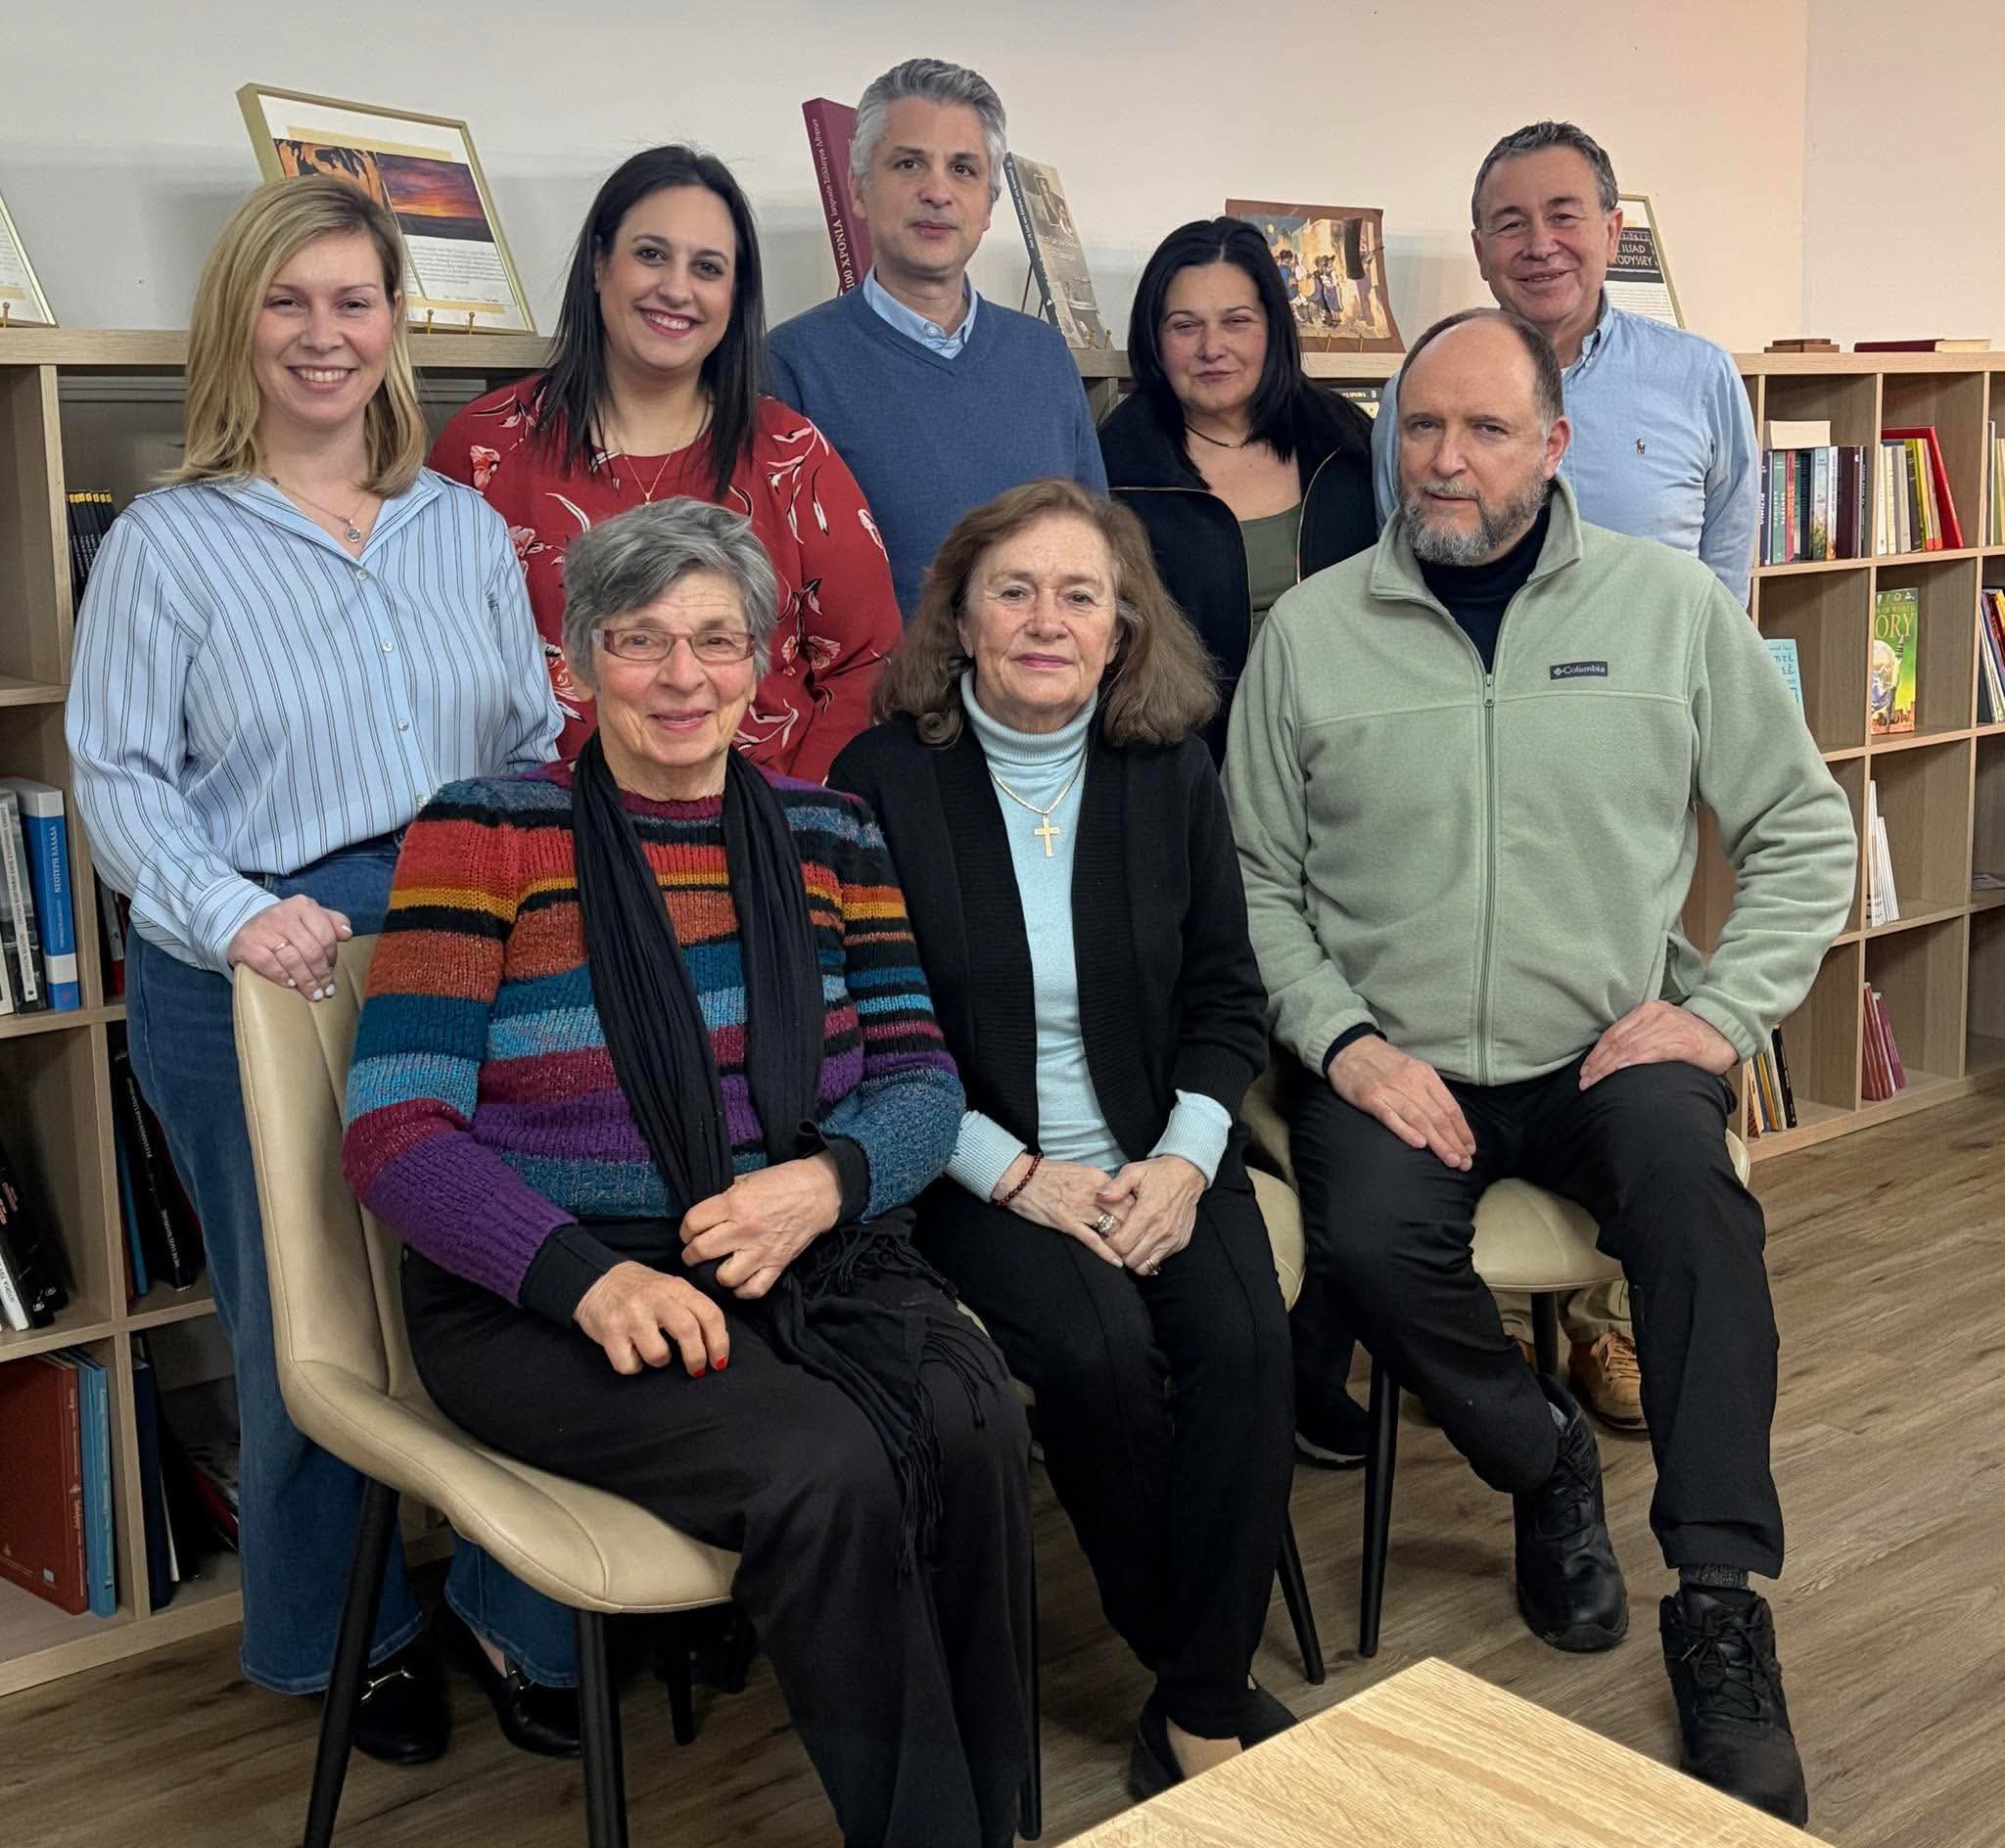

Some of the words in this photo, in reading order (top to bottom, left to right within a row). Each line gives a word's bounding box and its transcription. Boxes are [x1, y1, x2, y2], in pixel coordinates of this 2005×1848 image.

[833, 219, 851, 267] ΧΡΟΝΙΑ
[1617, 254, 1653, 266] ODYSSEY
[844, 270, 856, 290] 100
[1562, 664, 1606, 674] Columbia
